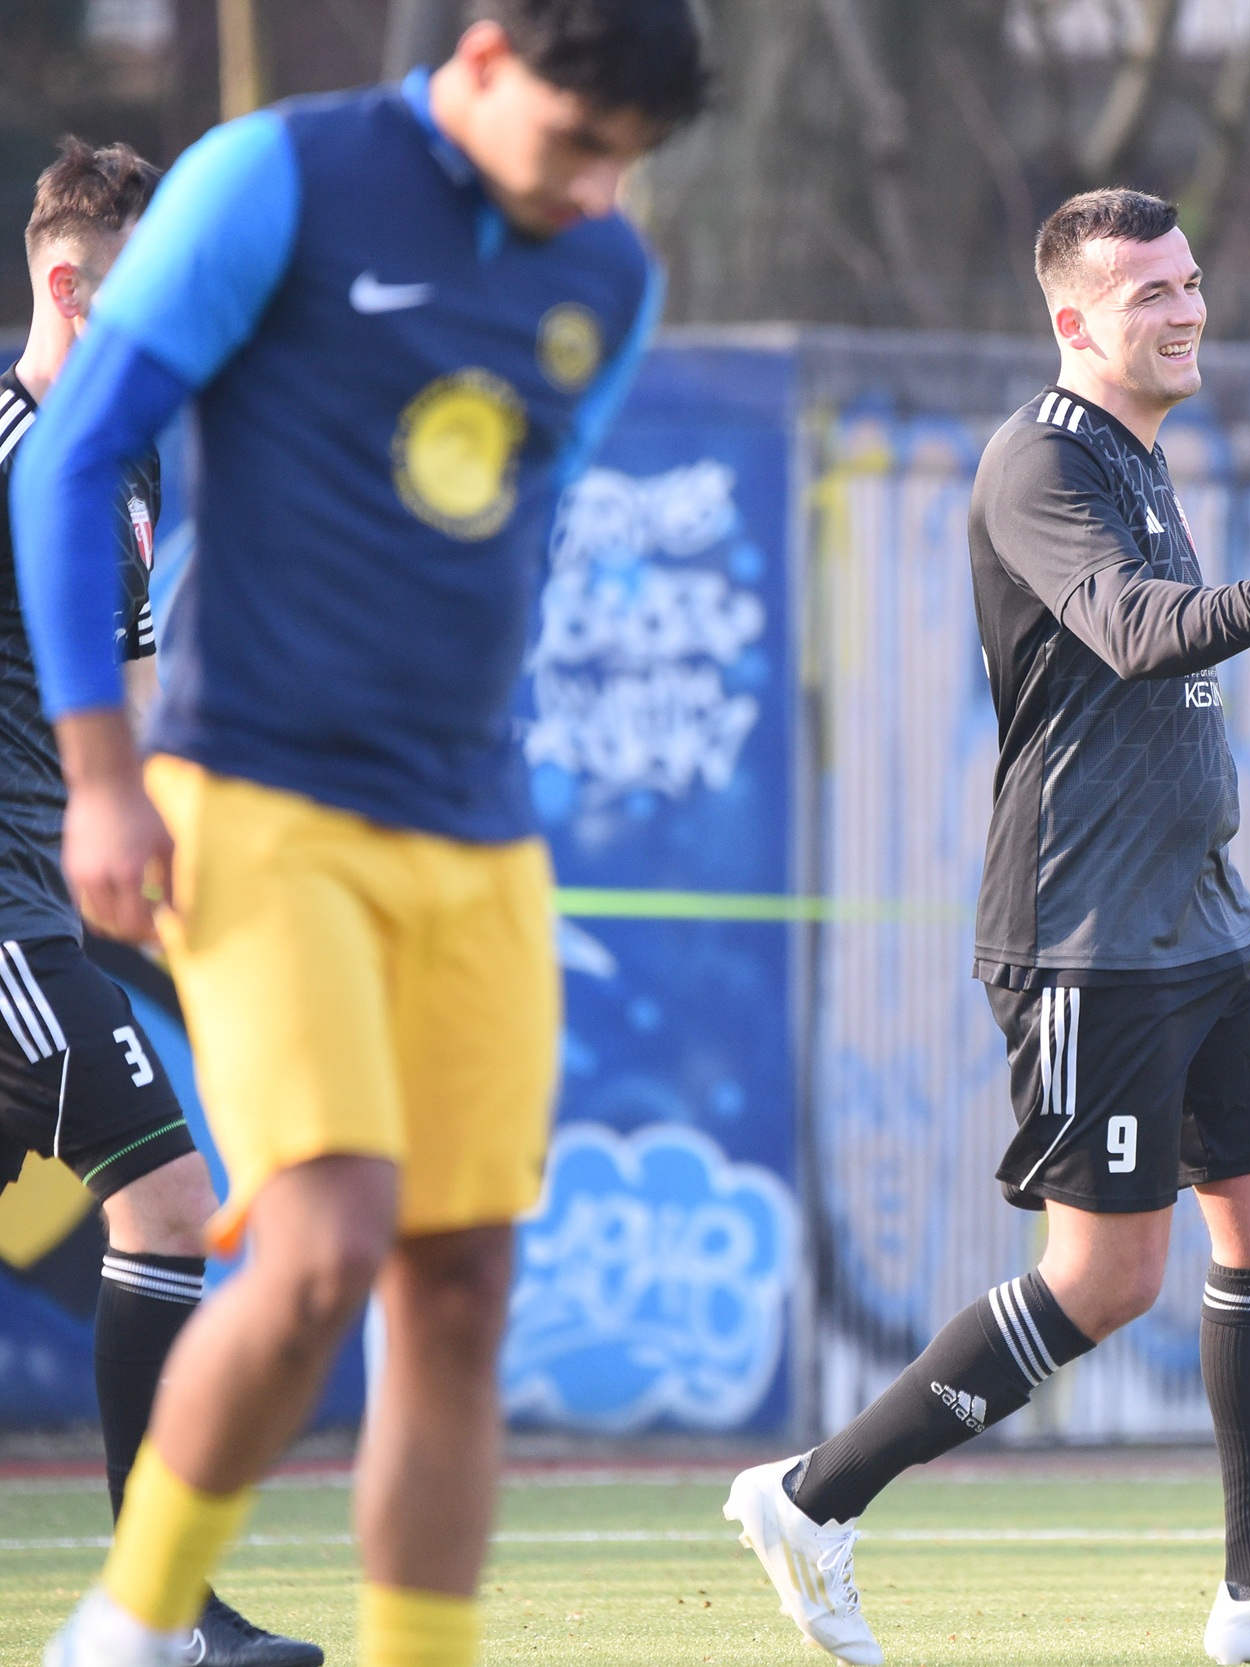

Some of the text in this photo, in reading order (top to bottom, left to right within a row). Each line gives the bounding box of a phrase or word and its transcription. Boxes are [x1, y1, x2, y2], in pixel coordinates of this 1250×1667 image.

[112, 1025, 154, 1088] 3
[1107, 1115, 1138, 1174] 9
[930, 1381, 985, 1433] adidas
